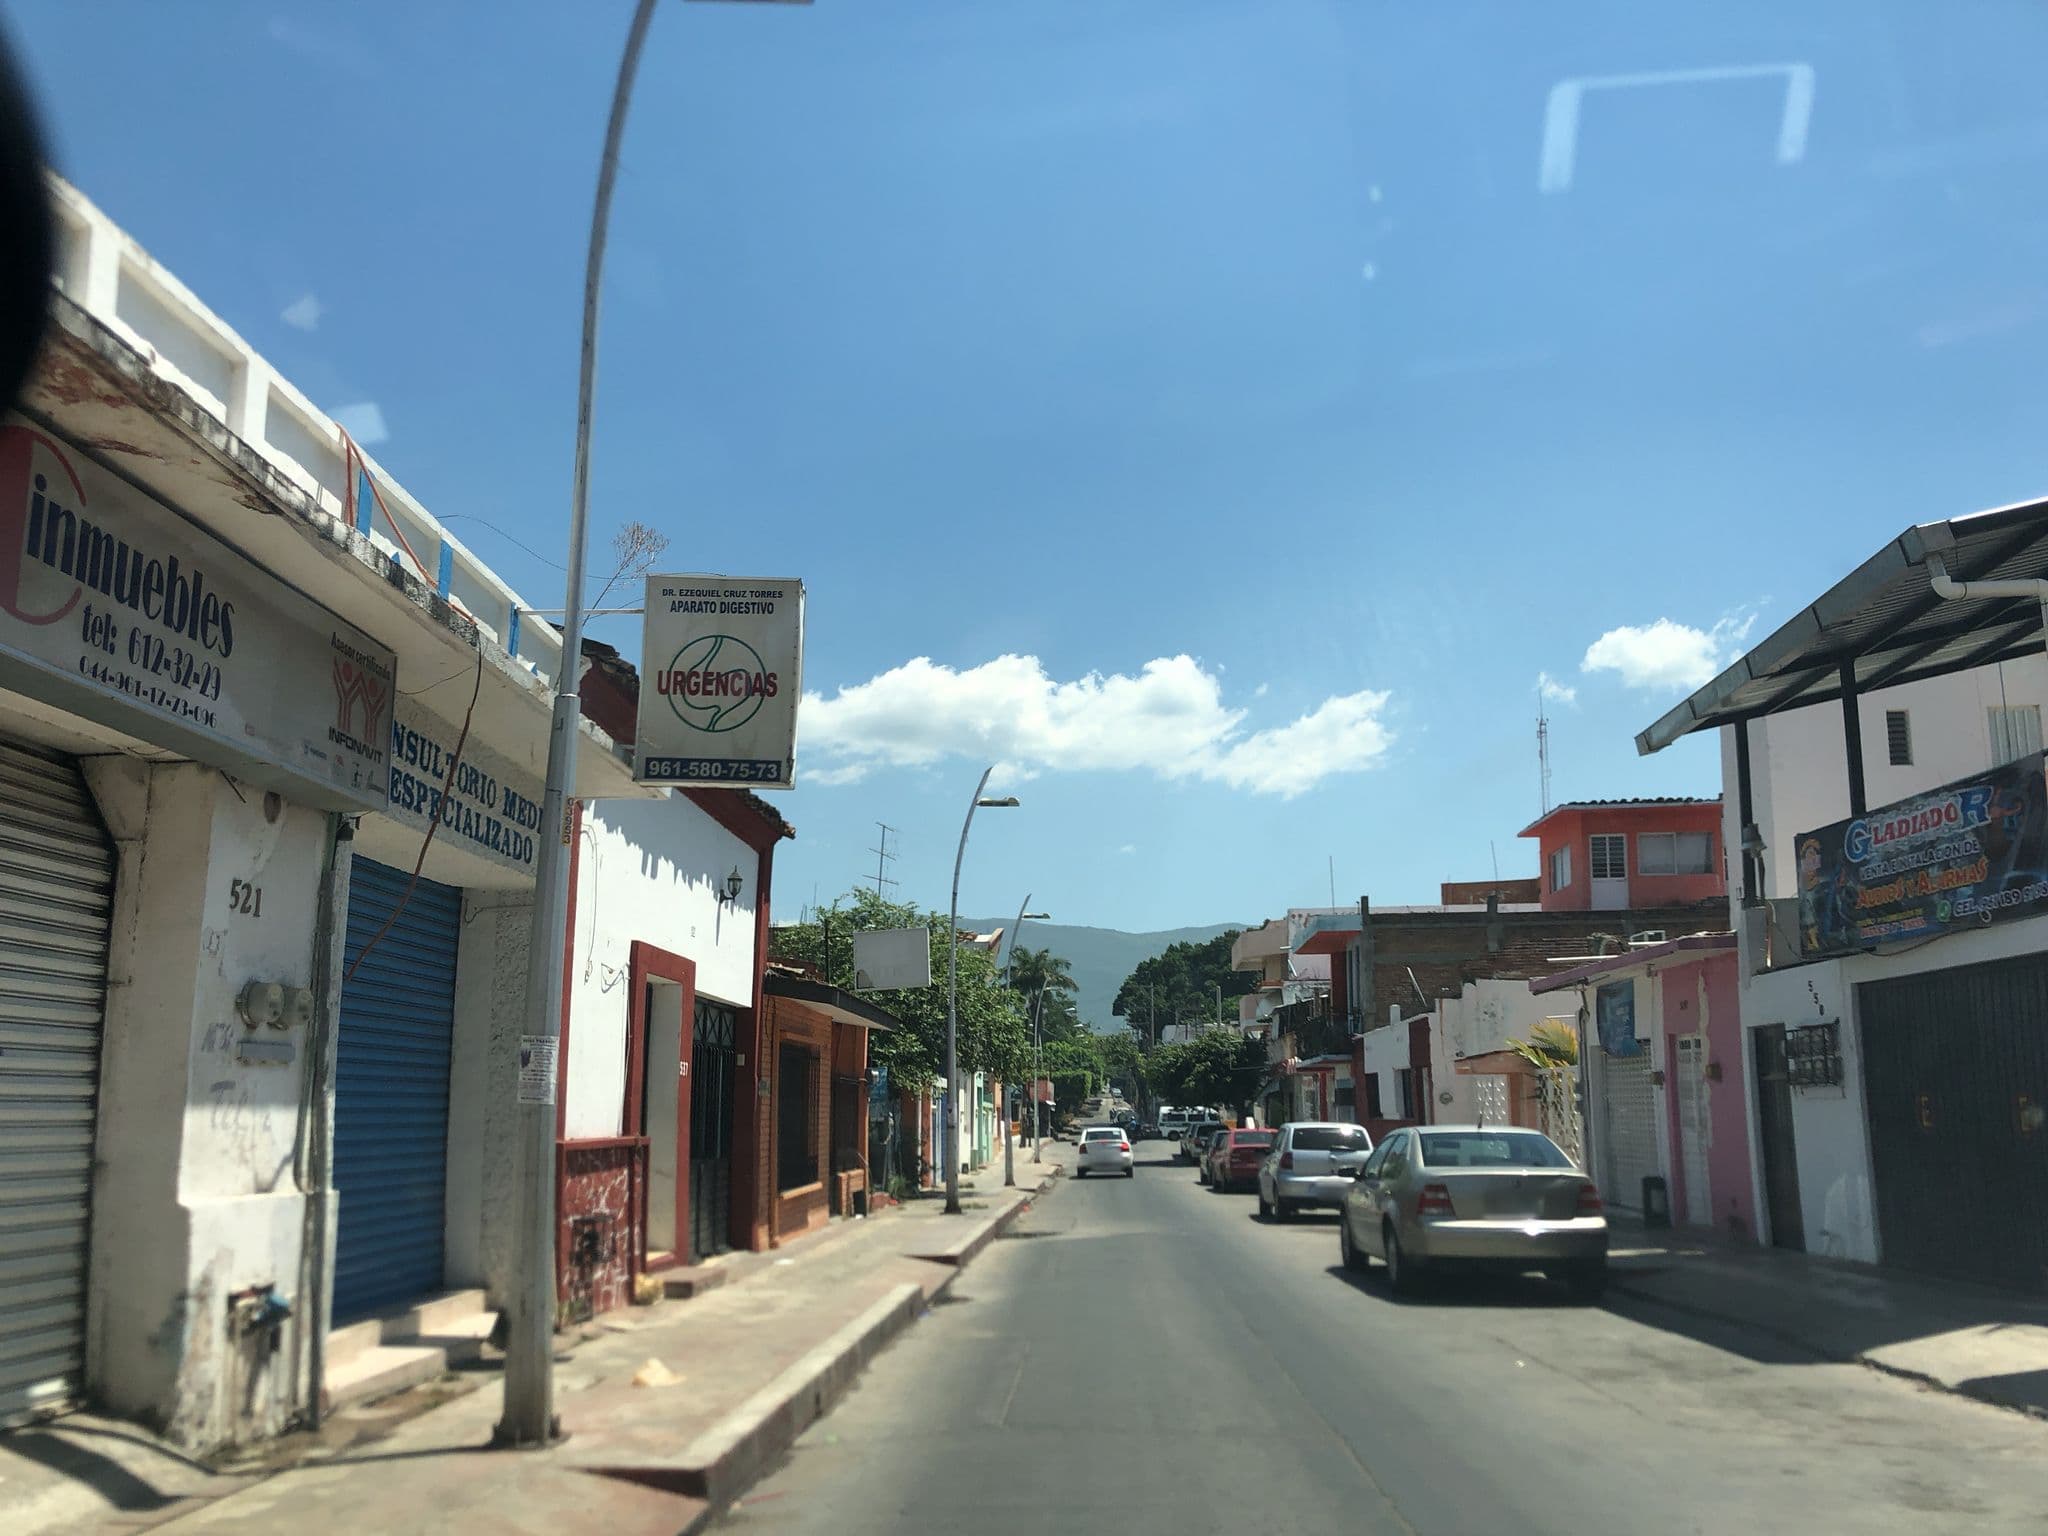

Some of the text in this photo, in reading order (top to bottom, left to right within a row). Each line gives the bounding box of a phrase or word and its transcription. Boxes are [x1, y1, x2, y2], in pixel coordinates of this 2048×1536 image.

[27, 473, 235, 658] inmuebles
[662, 588, 783, 599] DR. EZEQUIEL CRUZ TORRES
[670, 600, 774, 615] APARATO DIGESTIVO
[129, 627, 221, 701] 612-32-29
[657, 670, 778, 698] URGENCIAS
[328, 726, 384, 765] INFONAVIT
[649, 760, 778, 779] 961-580-75-73
[390, 766, 533, 864] ESPECIALIZADO
[1845, 785, 1993, 863] GLADIADOR
[228, 877, 263, 918] 521
[679, 1061, 689, 1076] 537
